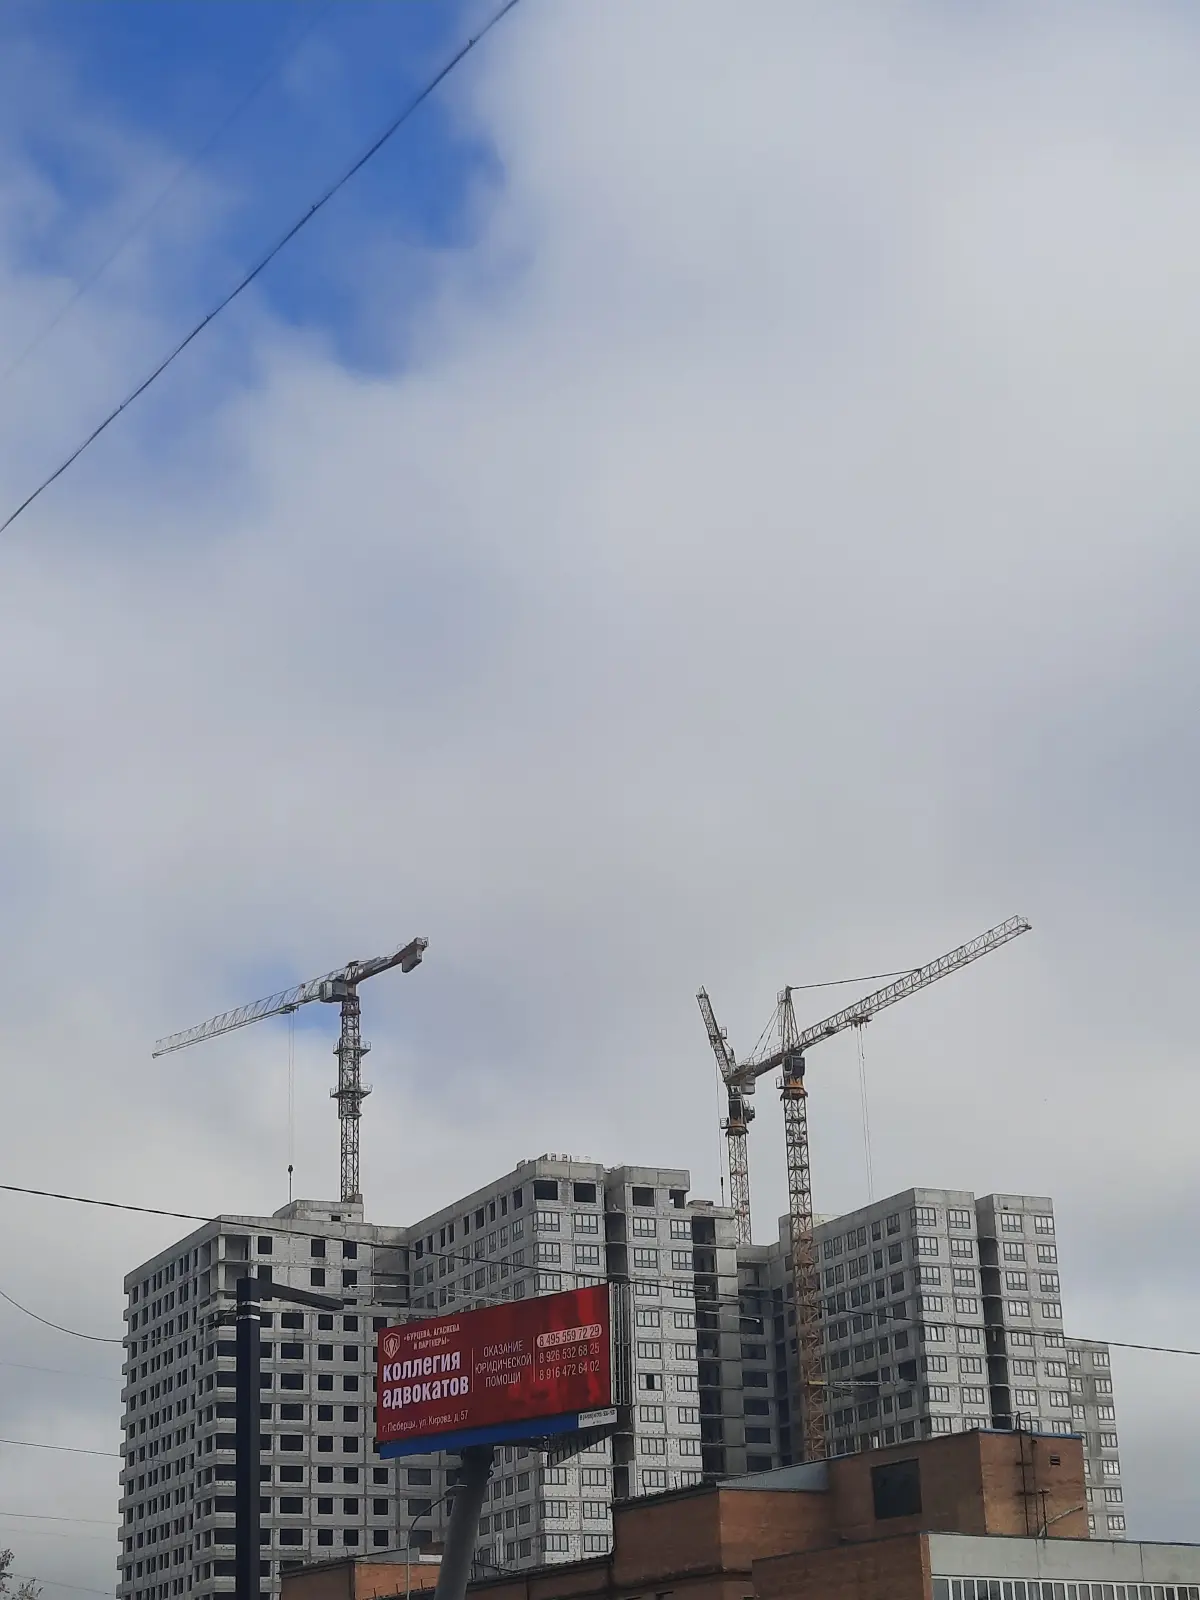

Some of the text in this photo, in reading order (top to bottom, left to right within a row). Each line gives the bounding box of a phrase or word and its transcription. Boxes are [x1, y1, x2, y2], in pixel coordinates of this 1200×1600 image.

[539, 1325, 600, 1347] 8 495 559 72 29
[483, 1340, 524, 1357] ОКАЗАНИЕ
[539, 1342, 600, 1364] 8 926 532 68 25
[475, 1352, 532, 1374] ЮРИДИЧЕСКОЙ
[539, 1359, 600, 1381] 8 916 472 64 02
[485, 1371, 521, 1388] ПОМОЩИ
[460, 1410, 469, 1420] 57
